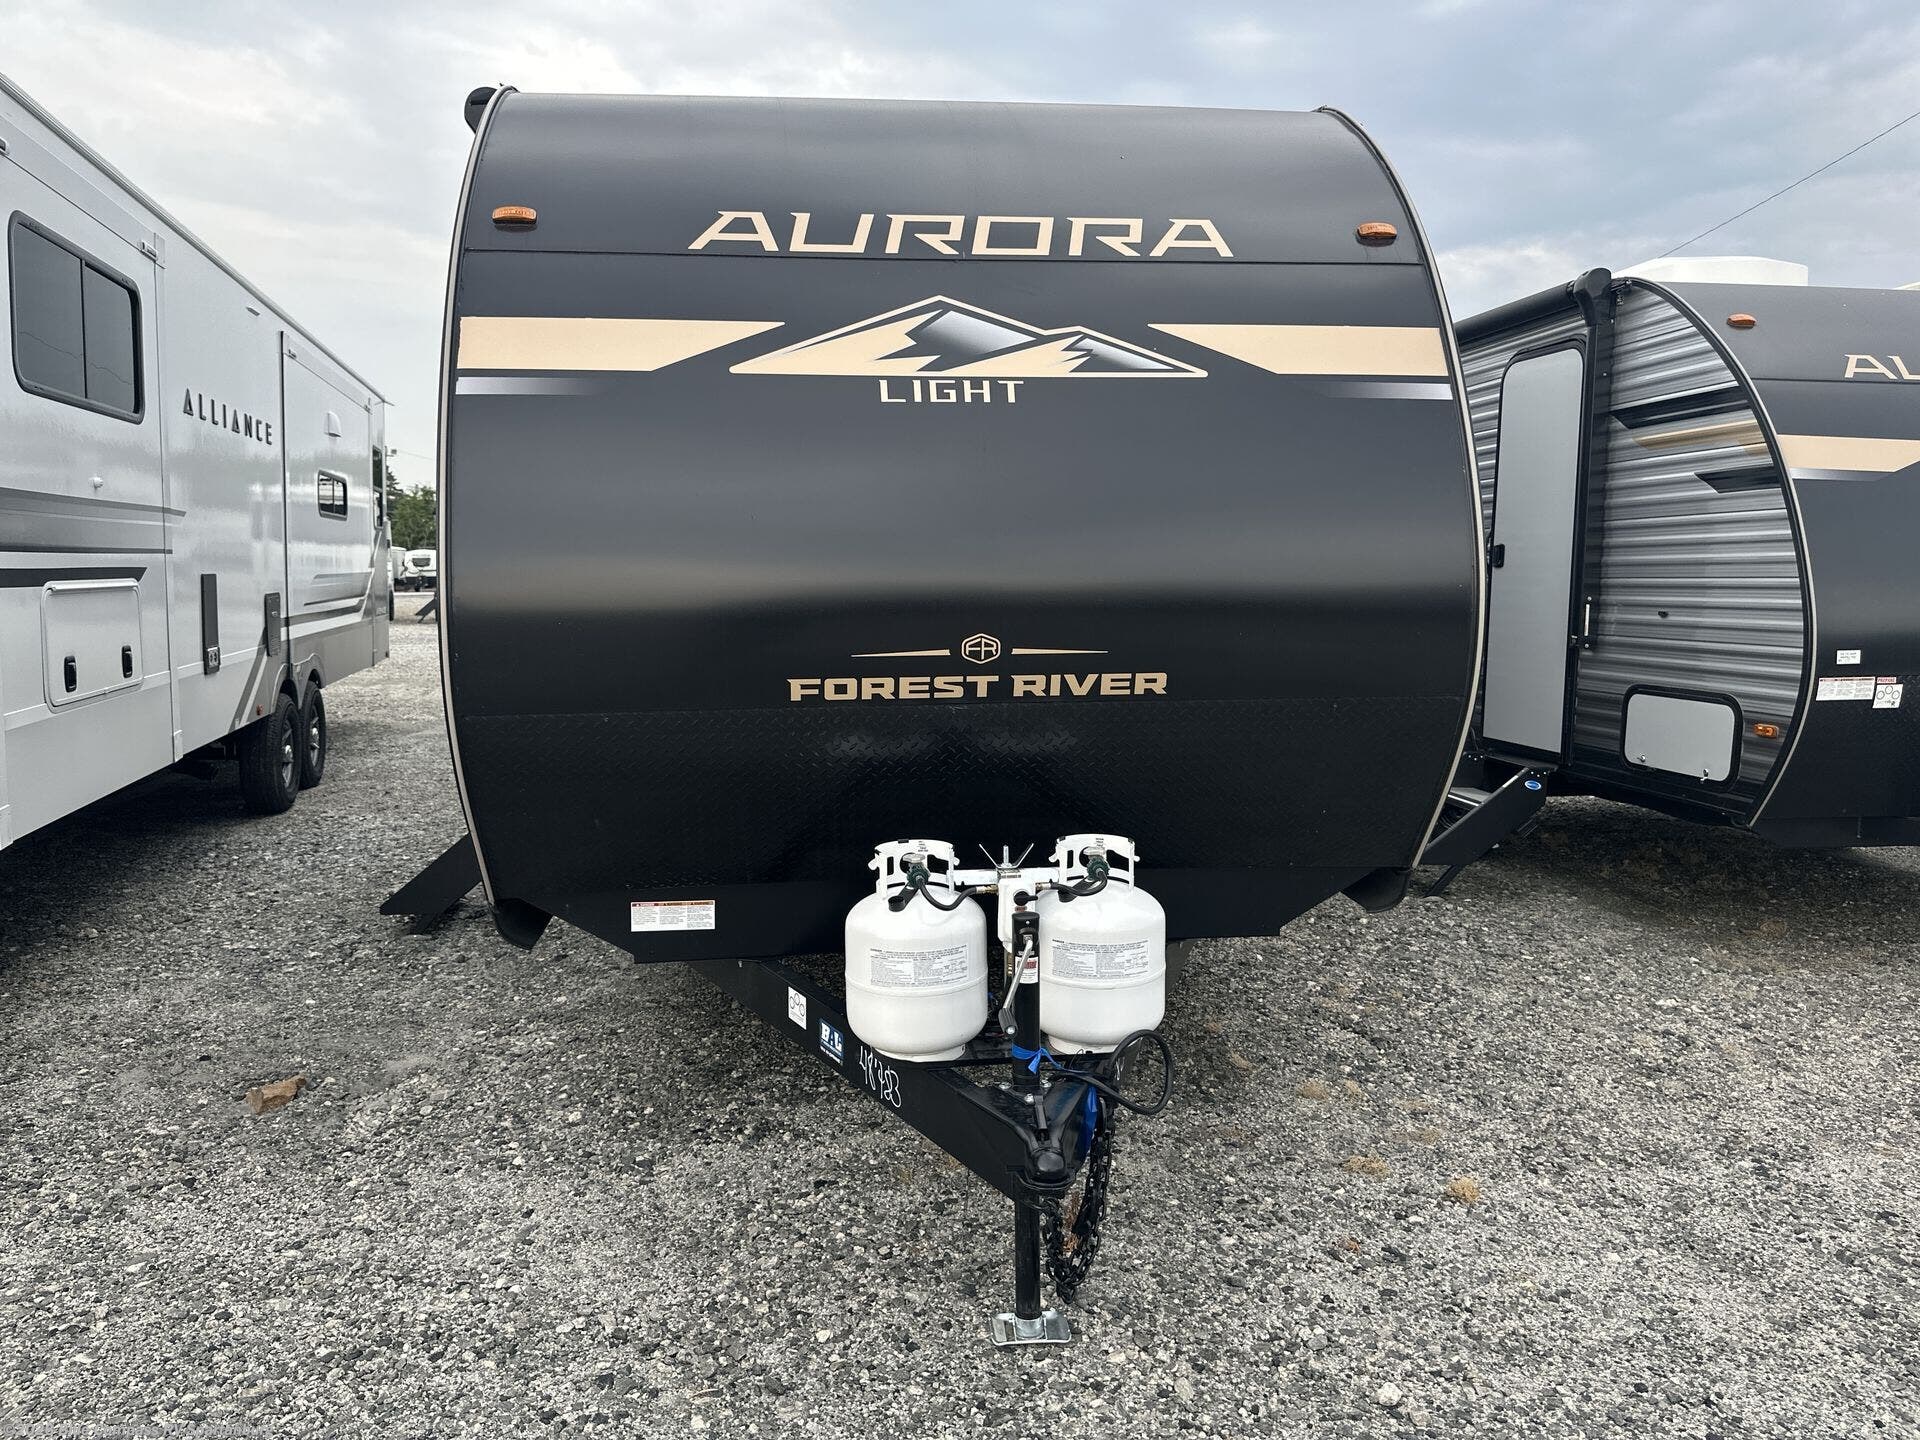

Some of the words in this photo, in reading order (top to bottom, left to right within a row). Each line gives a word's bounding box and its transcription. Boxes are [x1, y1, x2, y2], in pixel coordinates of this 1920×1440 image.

[688, 210, 1234, 258] AURORA
[878, 379, 1024, 404] LIGHT
[182, 387, 273, 446] ALLIANCE
[786, 674, 1000, 702] FOREST
[1010, 671, 1169, 697] RIVER
